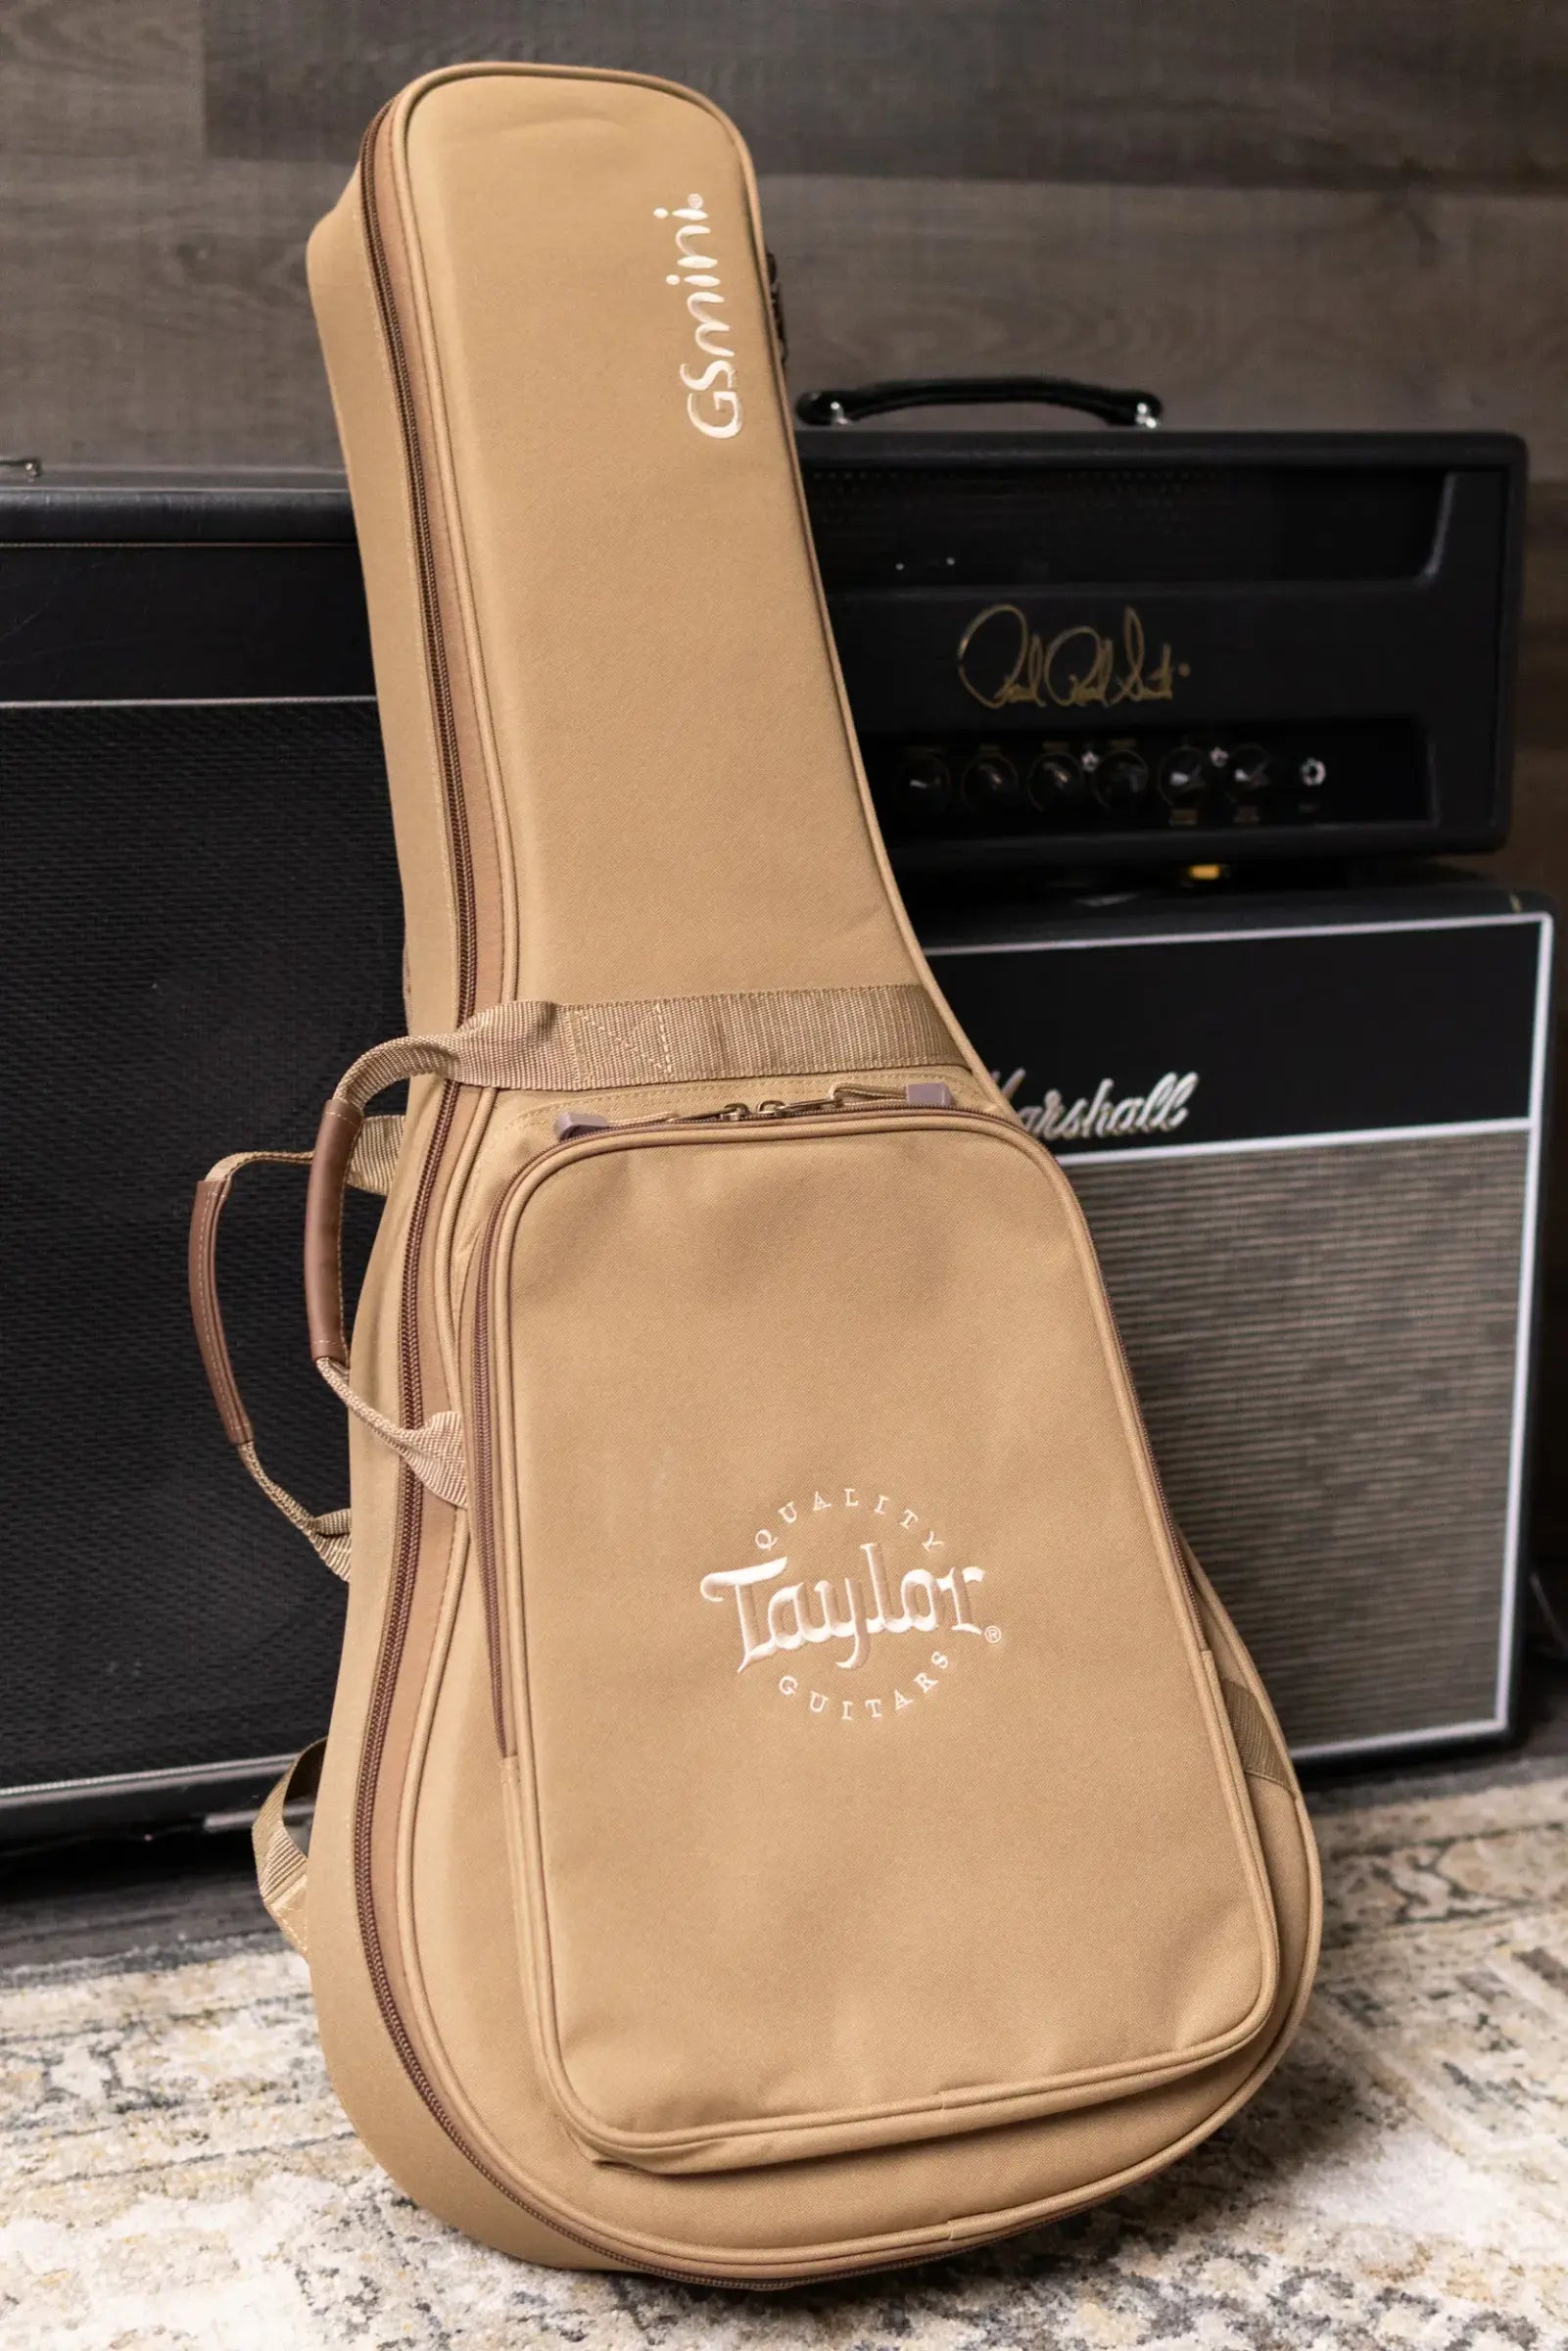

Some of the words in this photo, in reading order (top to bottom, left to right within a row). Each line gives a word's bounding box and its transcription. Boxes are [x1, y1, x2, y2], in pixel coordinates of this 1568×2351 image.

[990, 1067, 1199, 1140] arshall
[755, 1487, 945, 1552] QUALITY
[779, 1651, 949, 1721] GUITARS
